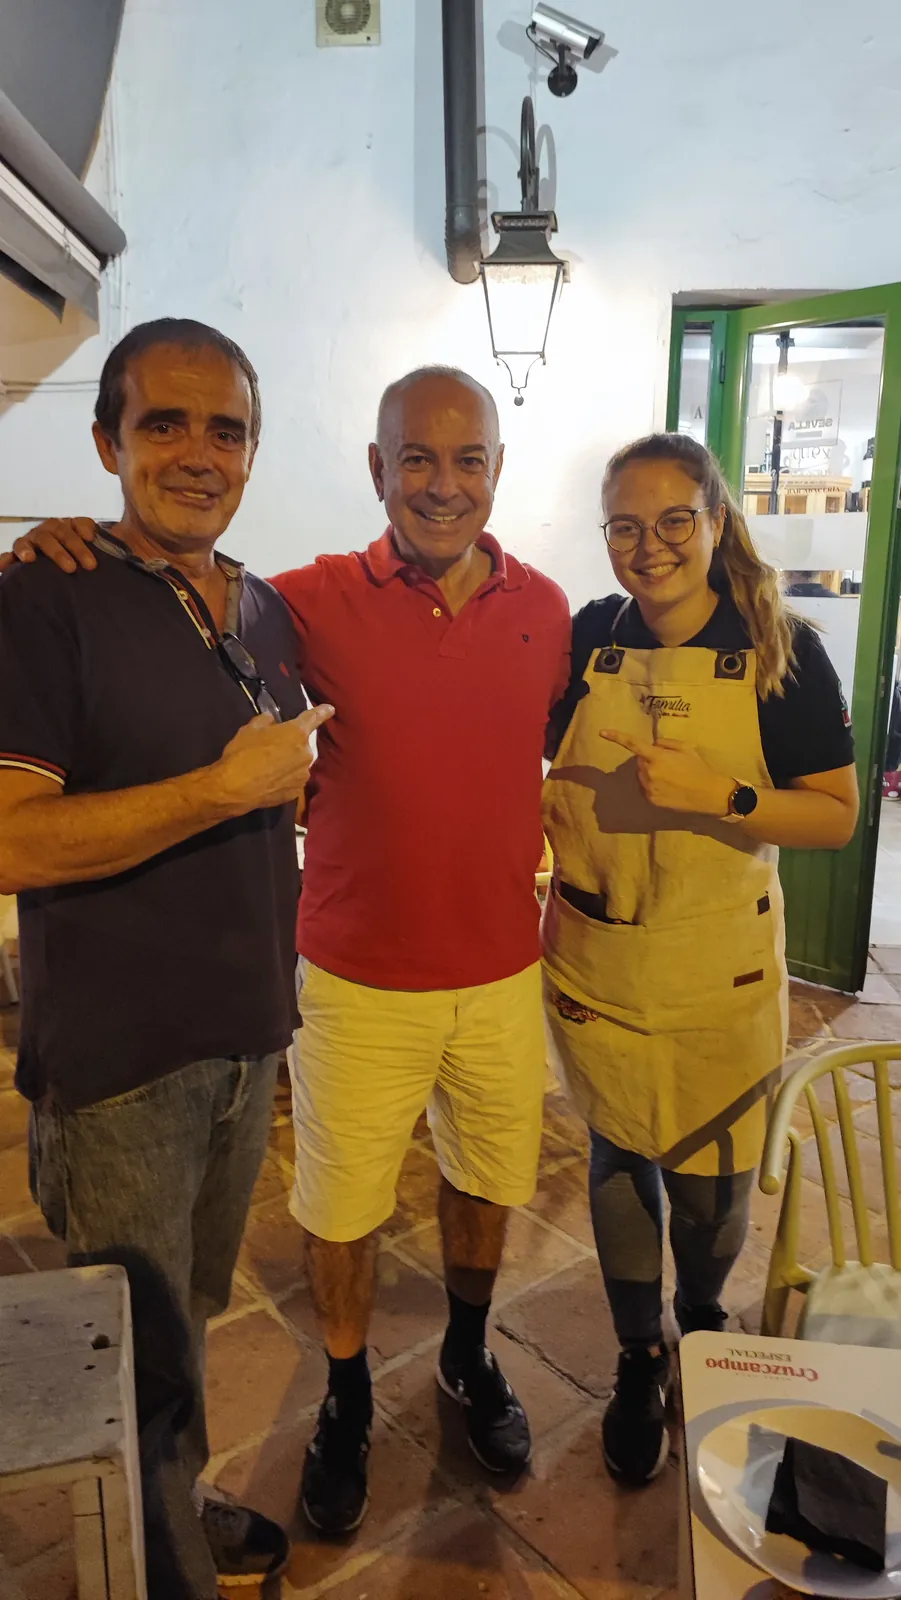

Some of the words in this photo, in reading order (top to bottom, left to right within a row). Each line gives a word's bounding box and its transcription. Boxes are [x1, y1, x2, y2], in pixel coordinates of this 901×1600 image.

[646, 695, 692, 711] Familia
[727, 1348, 792, 1362] ESPECIAL
[705, 1358, 819, 1382] Cruzcampo
